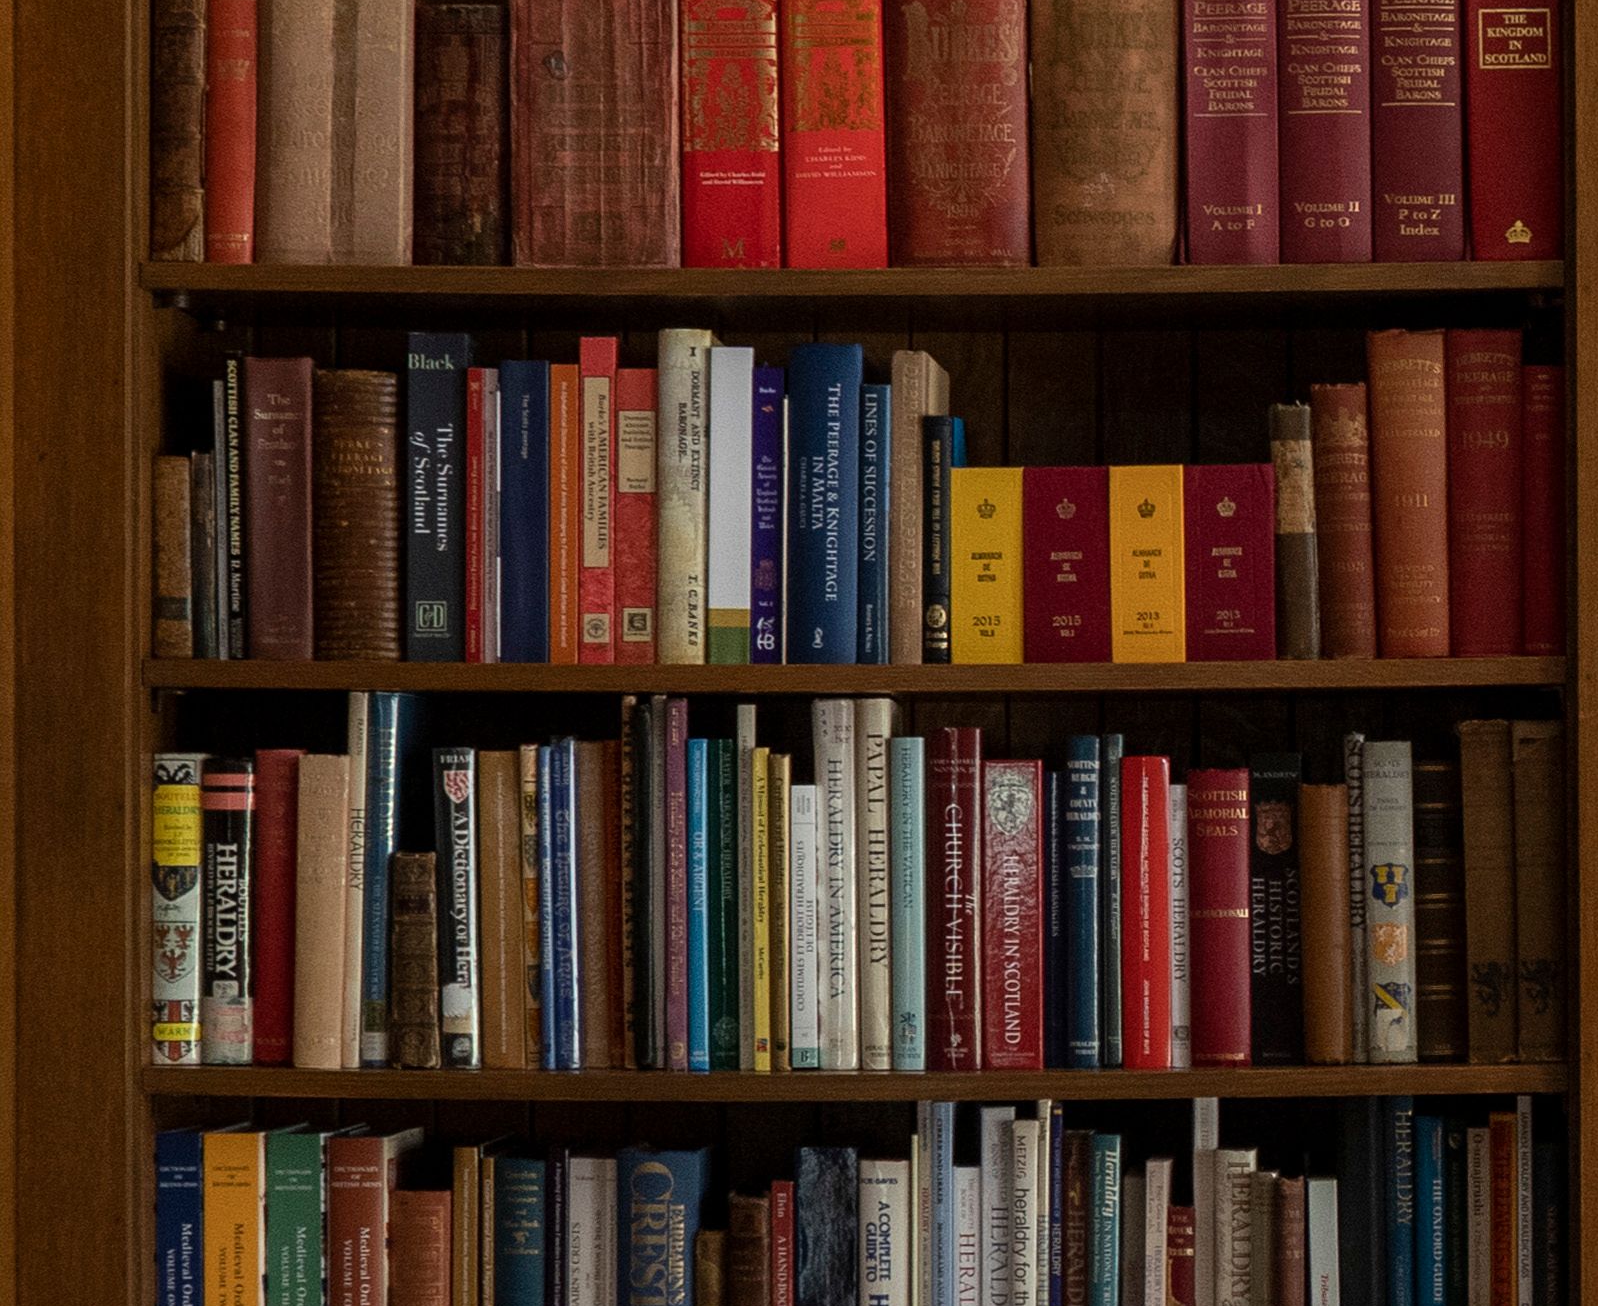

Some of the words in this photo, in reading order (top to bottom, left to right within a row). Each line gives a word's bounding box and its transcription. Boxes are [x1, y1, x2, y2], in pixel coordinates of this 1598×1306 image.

[1487, 27, 1543, 37] KINGDOM
[1504, 15, 1526, 23] THE
[1485, 53, 1546, 63] SCOTLAND
[1509, 40, 1521, 50] IN
[408, 353, 454, 369] Black
[409, 431, 430, 451] of
[438, 423, 452, 457] The
[414, 457, 430, 533] Scotland
[437, 463, 452, 549] Surnames
[867, 733, 885, 812] PAPAL
[215, 843, 238, 977] HERALDRY
[868, 829, 888, 967] HERALDRY
[1004, 855, 1019, 935] HERALDRY
[1004, 939, 1019, 956] IN
[1004, 961, 1020, 1043] SCOTLAND
[878, 1201, 890, 1211] A
[1012, 1188, 1030, 1259] heraldry
[359, 1227, 370, 1279] Medieval
[866, 1221, 878, 1262] GUIDE
[878, 1213, 891, 1281] COMPLETE
[343, 1239, 353, 1286] VOLUME
[866, 1266, 877, 1282] TO
[1015, 1261, 1030, 1288] for
